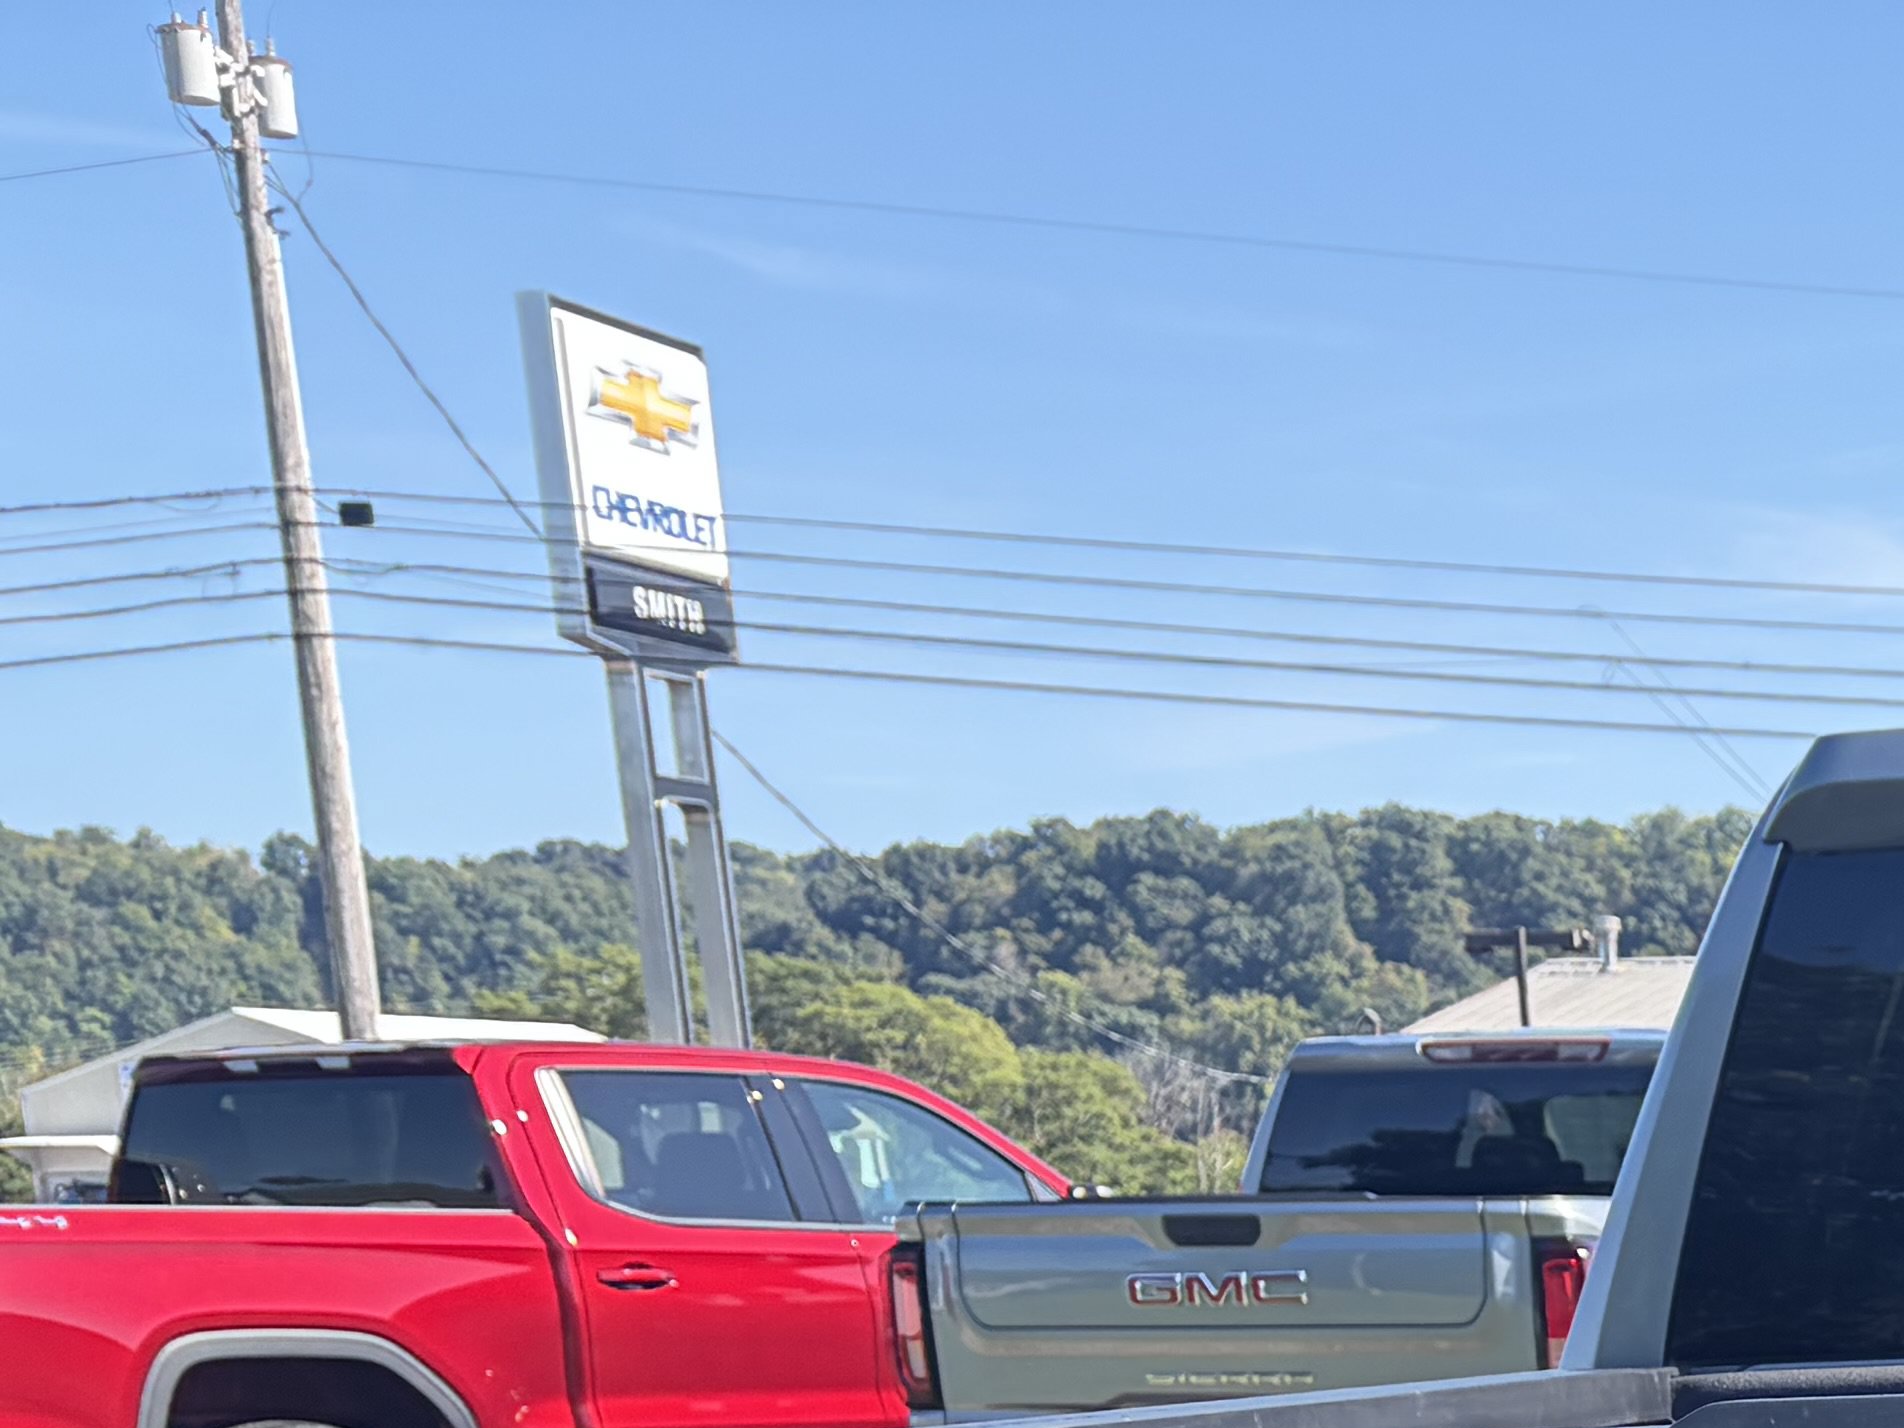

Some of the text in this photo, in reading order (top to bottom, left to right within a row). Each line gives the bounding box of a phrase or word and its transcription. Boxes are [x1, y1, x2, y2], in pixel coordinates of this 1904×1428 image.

[592, 484, 717, 550] CHEVROLET
[632, 586, 705, 622] SMITH
[1126, 1269, 1309, 1308] GMC
